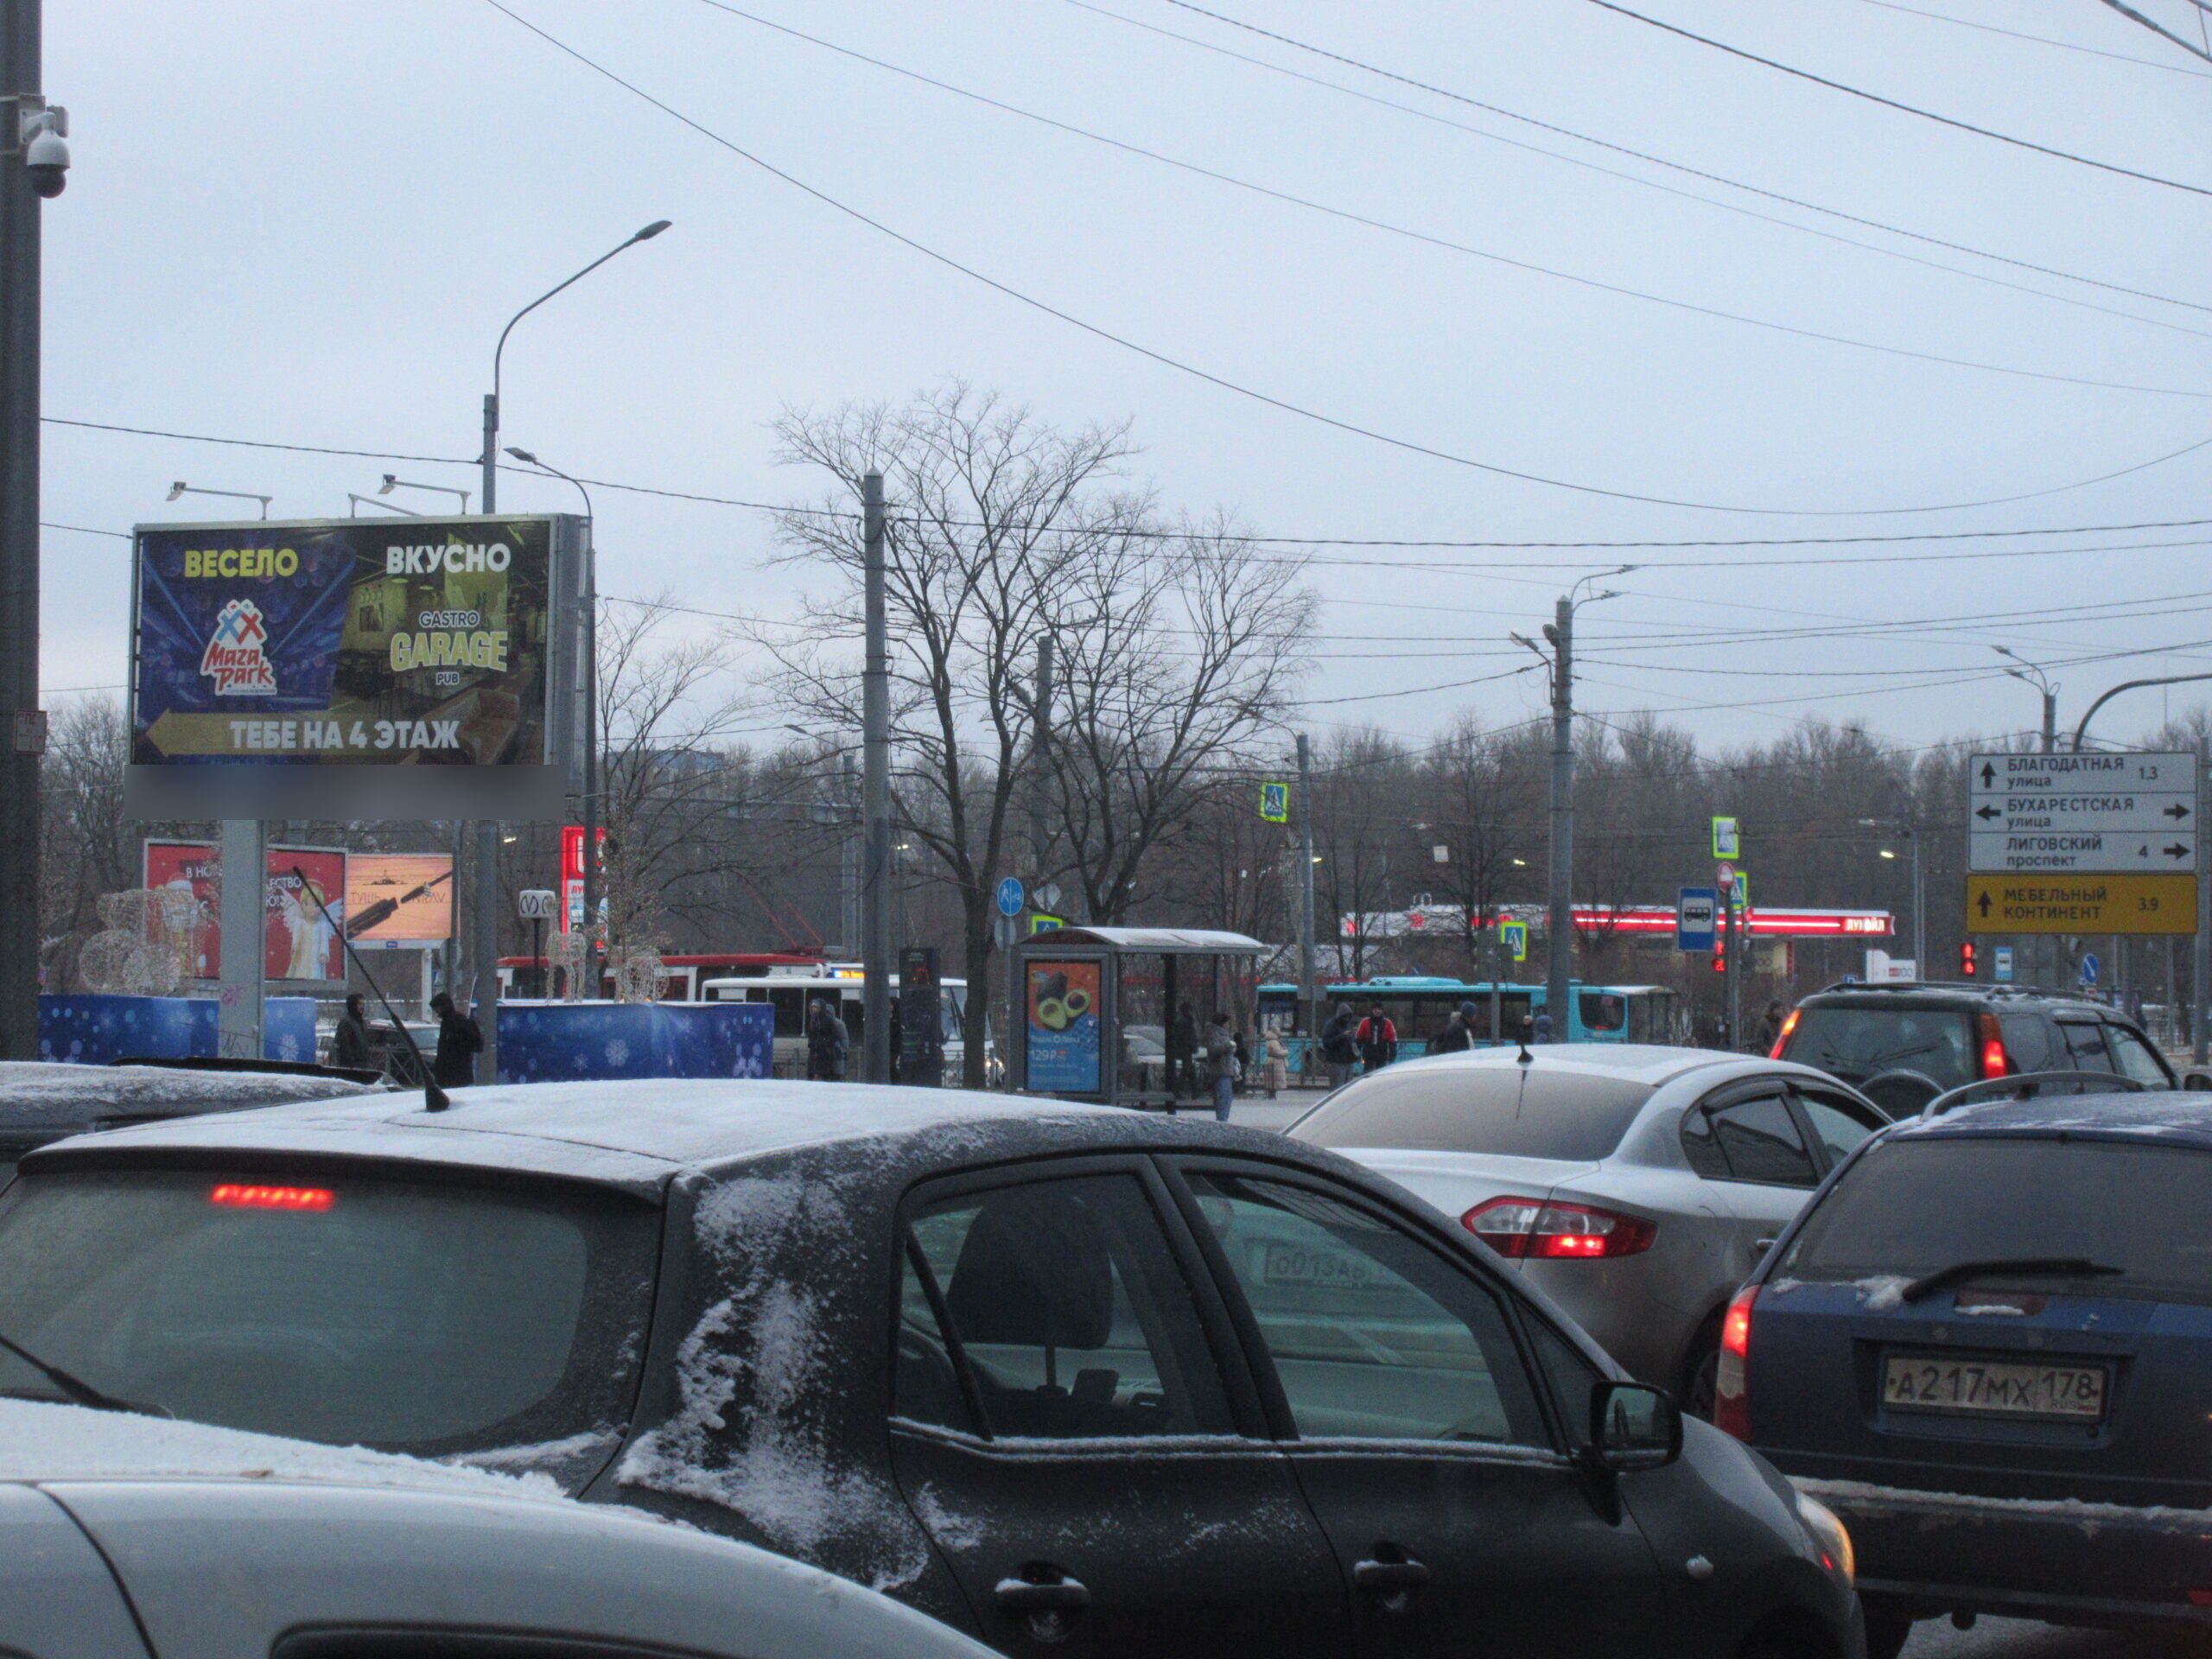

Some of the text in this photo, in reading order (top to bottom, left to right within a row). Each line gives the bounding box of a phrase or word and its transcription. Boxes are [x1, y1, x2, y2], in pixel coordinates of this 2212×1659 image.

[184, 549, 299, 577] ВЕСЕЛО
[386, 543, 512, 575] ВКУСНО
[419, 610, 480, 628] GASTRO
[391, 632, 508, 672] GARAGE
[436, 671, 460, 685] PUB
[230, 721, 460, 749] ТЕБЕ НА 4 ЭТАЖ
[2007, 757, 2125, 772] БЛАГОДАТНАЯ
[2006, 777, 2052, 790] улица
[2007, 798, 2134, 811] БУХАРЕСТСКАЯ
[2006, 817, 2052, 830] улица
[2006, 832, 2149, 858] ЛИГОВСКИЙ 4
[2006, 855, 2076, 868] проспект
[2004, 886, 2107, 901] МЕБЕЛЬНЫЙ
[2004, 906, 2101, 919] КОНТИНЕНТ
